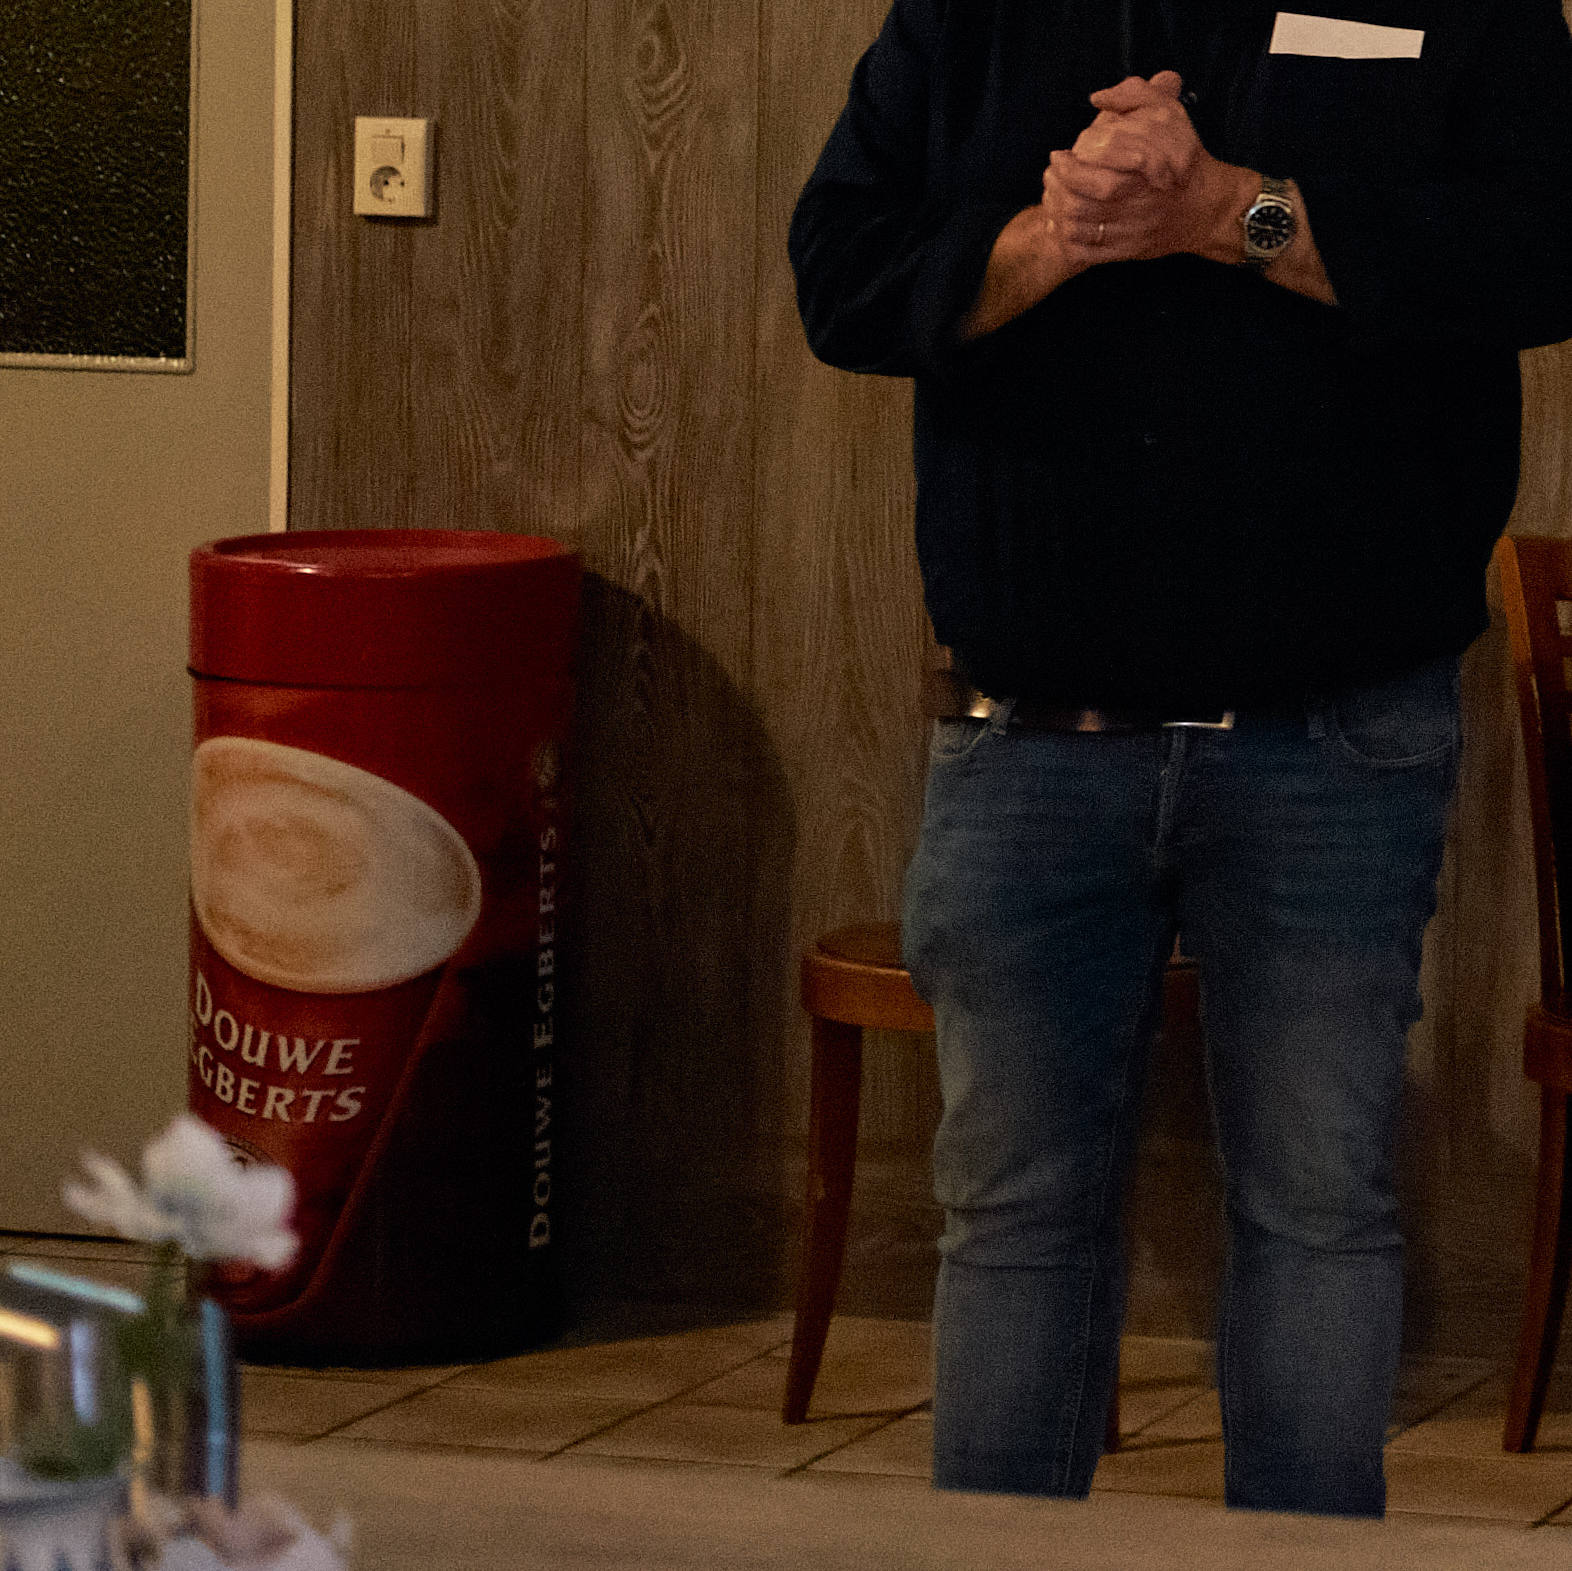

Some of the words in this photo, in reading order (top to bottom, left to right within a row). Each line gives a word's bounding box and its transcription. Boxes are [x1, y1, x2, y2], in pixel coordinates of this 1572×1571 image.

[195, 968, 361, 1076] DOUWE
[533, 826, 557, 1050] EGBERTS
[528, 1062, 553, 1250] DOUWE
